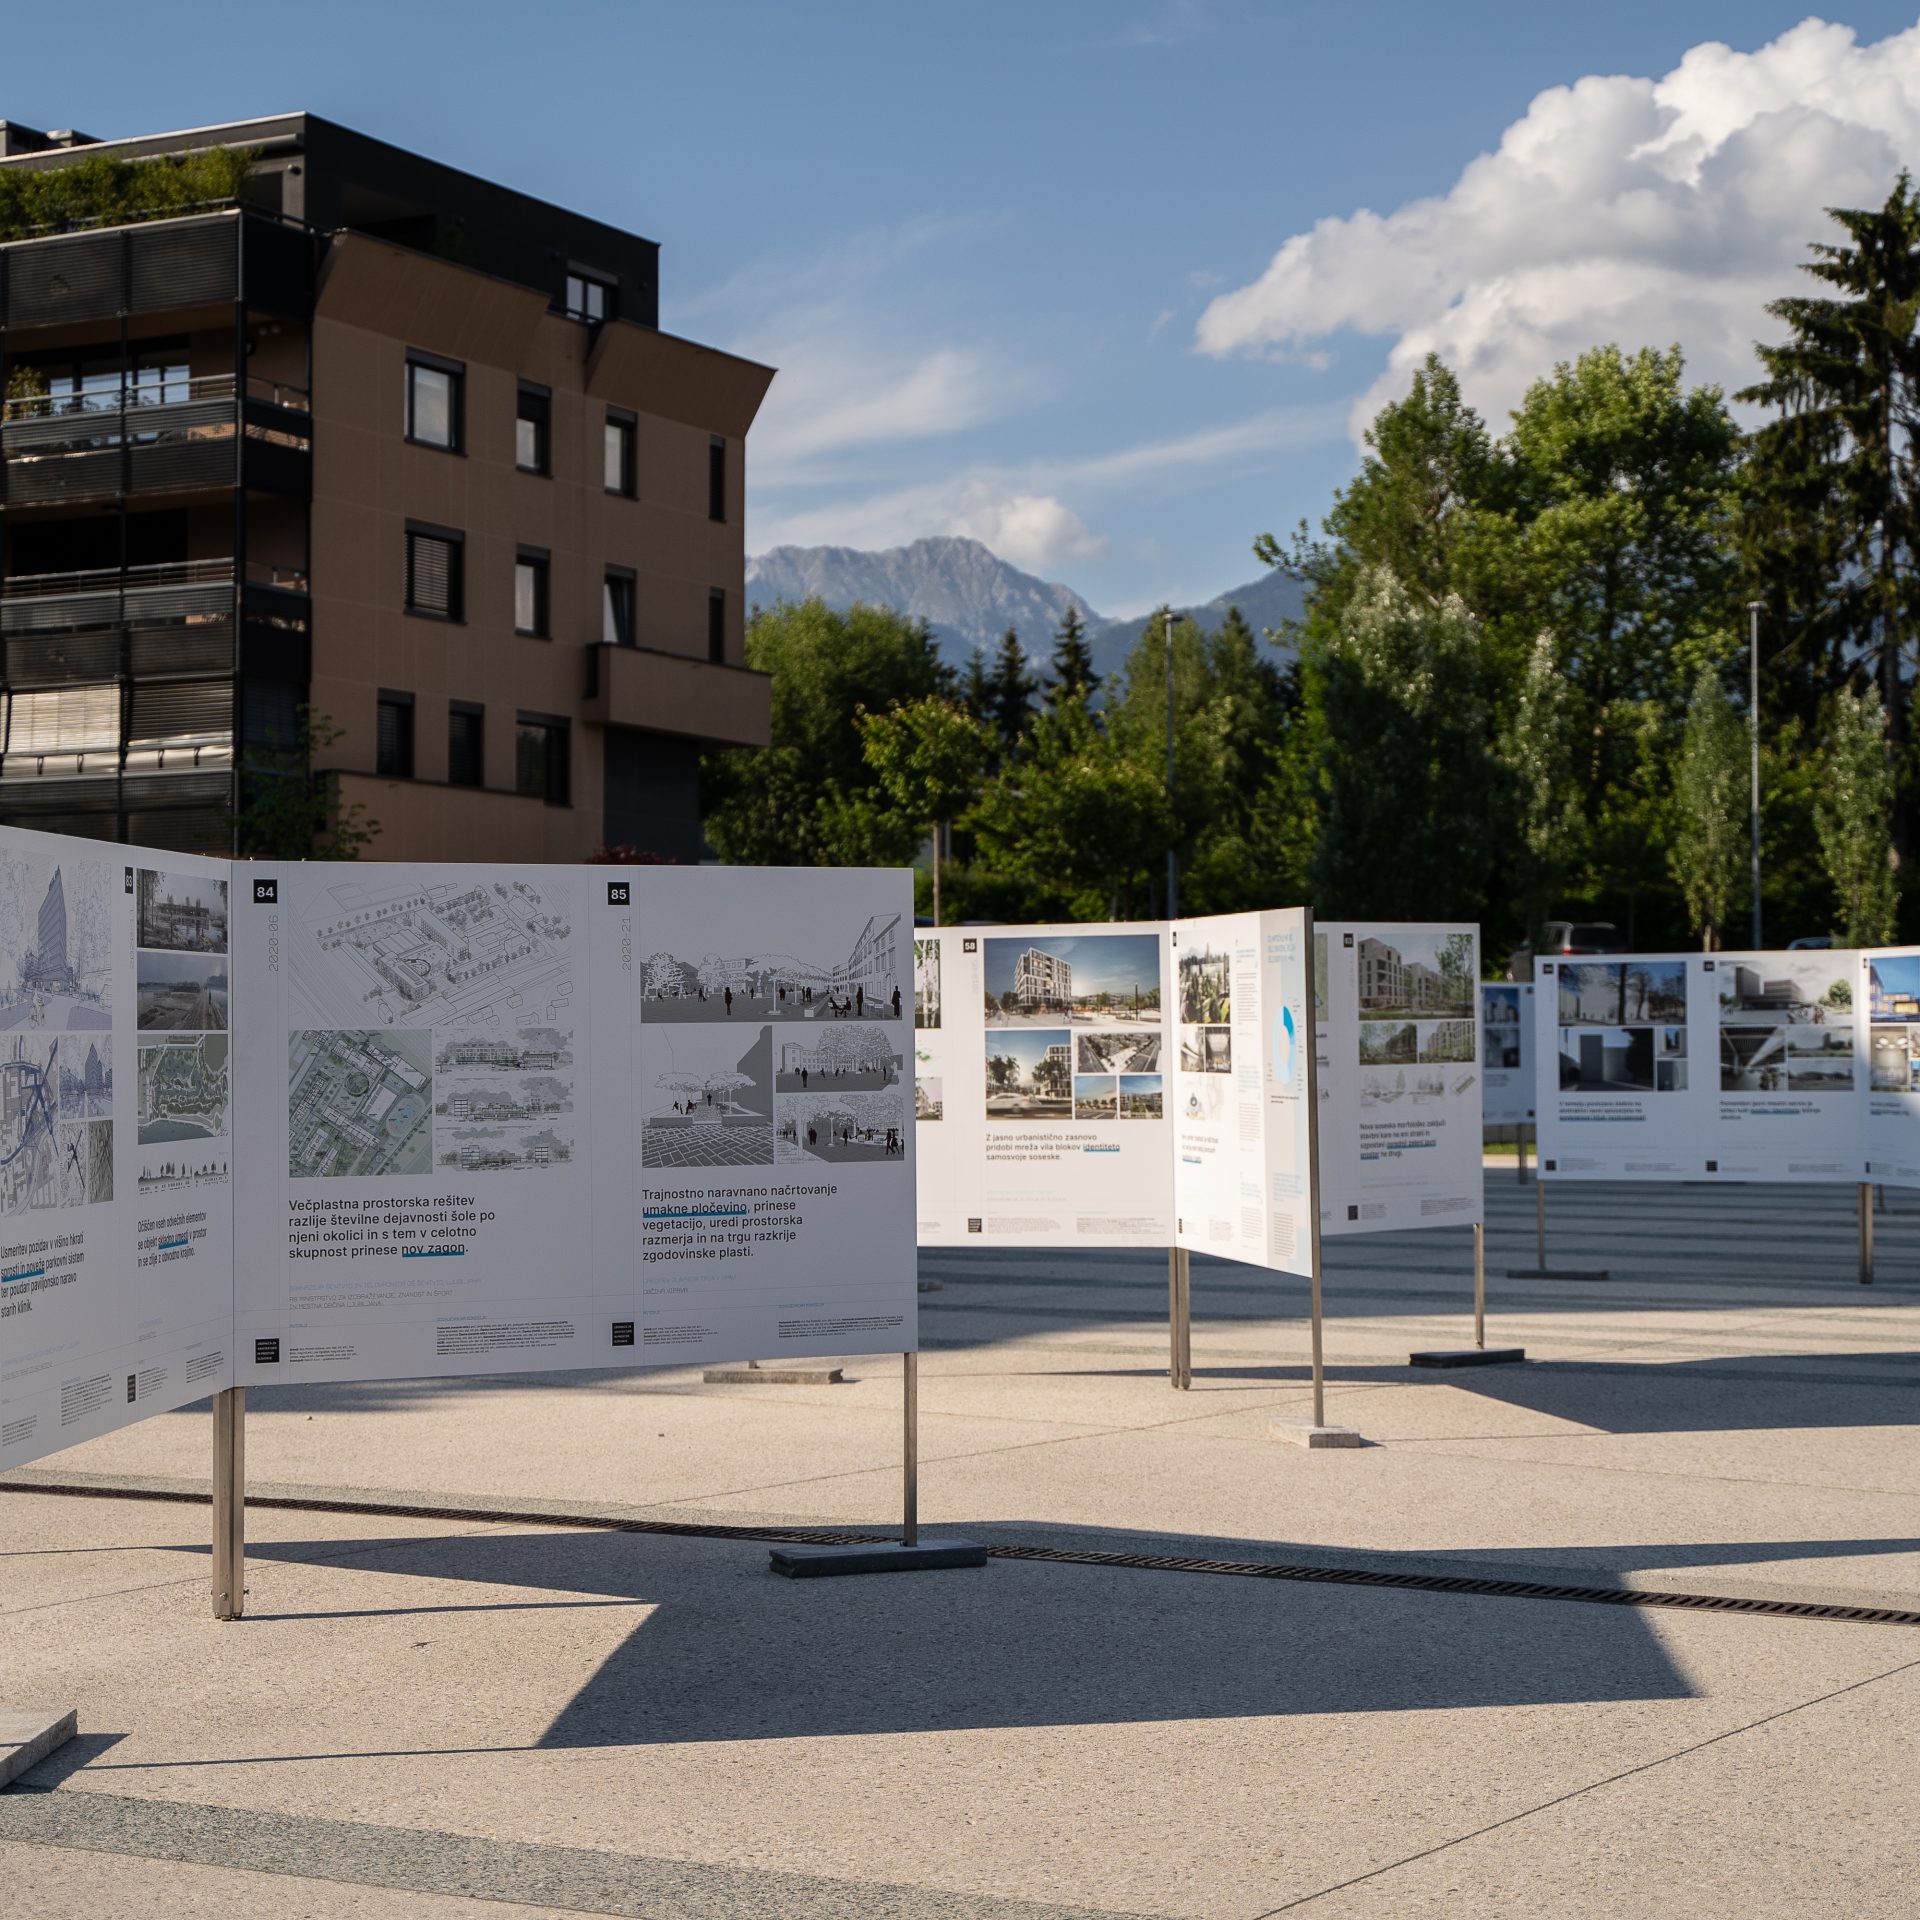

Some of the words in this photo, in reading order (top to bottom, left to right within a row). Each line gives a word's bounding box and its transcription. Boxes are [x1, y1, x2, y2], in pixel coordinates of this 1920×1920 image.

[126, 874, 133, 887] 83
[256, 886, 274, 898] 84
[611, 889, 627, 900] 85
[965, 942, 976, 950] 58
[993, 1134, 1013, 1142] jasno
[1015, 1133, 1063, 1141] urbanistično
[986, 1143, 1013, 1152] pridobi
[1014, 1143, 1039, 1151] mreža
[1040, 1143, 1054, 1151] vila
[1083, 1143, 1120, 1151] identiteto
[986, 1153, 1027, 1162] samosvoje
[1028, 1153, 1063, 1161] soseske.
[642, 1188, 704, 1202] Trajnostno
[707, 1187, 768, 1198] naravnano
[770, 1183, 838, 1197] načrtovanje
[289, 1199, 359, 1213] Večplastna
[363, 1197, 430, 1211] prostorska
[433, 1195, 475, 1207] rešitev
[642, 1204, 688, 1215] umakne
[691, 1201, 751, 1217] pločevino,
[753, 1201, 796, 1213] prinese
[289, 1215, 327, 1229] razlije
[330, 1213, 379, 1226] številne
[383, 1211, 447, 1226] dejavnosti
[451, 1210, 476, 1222] šole
[479, 1211, 495, 1224] po
[642, 1218, 706, 1232] vegetacijo,
[709, 1216, 739, 1228] uredi
[742, 1215, 803, 1228] prostorska
[289, 1231, 319, 1245] njeni
[323, 1229, 363, 1242] okolici
[367, 1229, 378, 1240] in
[382, 1231, 389, 1240] s
[392, 1229, 416, 1239] tem
[420, 1229, 427, 1238] v
[431, 1226, 477, 1238] celotno
[642, 1233, 694, 1247] razmerja
[696, 1232, 707, 1244] in
[710, 1233, 724, 1243] na
[727, 1231, 751, 1245] trgu
[754, 1229, 797, 1243] razkrije
[289, 1246, 348, 1260] skupnost
[351, 1245, 398, 1259] prinese
[401, 1246, 424, 1255] nov
[427, 1243, 469, 1256] zagon.
[642, 1247, 716, 1263] zgodovinske
[719, 1246, 754, 1260] plasti.
[1, 1302, 17, 1318] starih
[17, 1299, 33, 1316] klinik.
